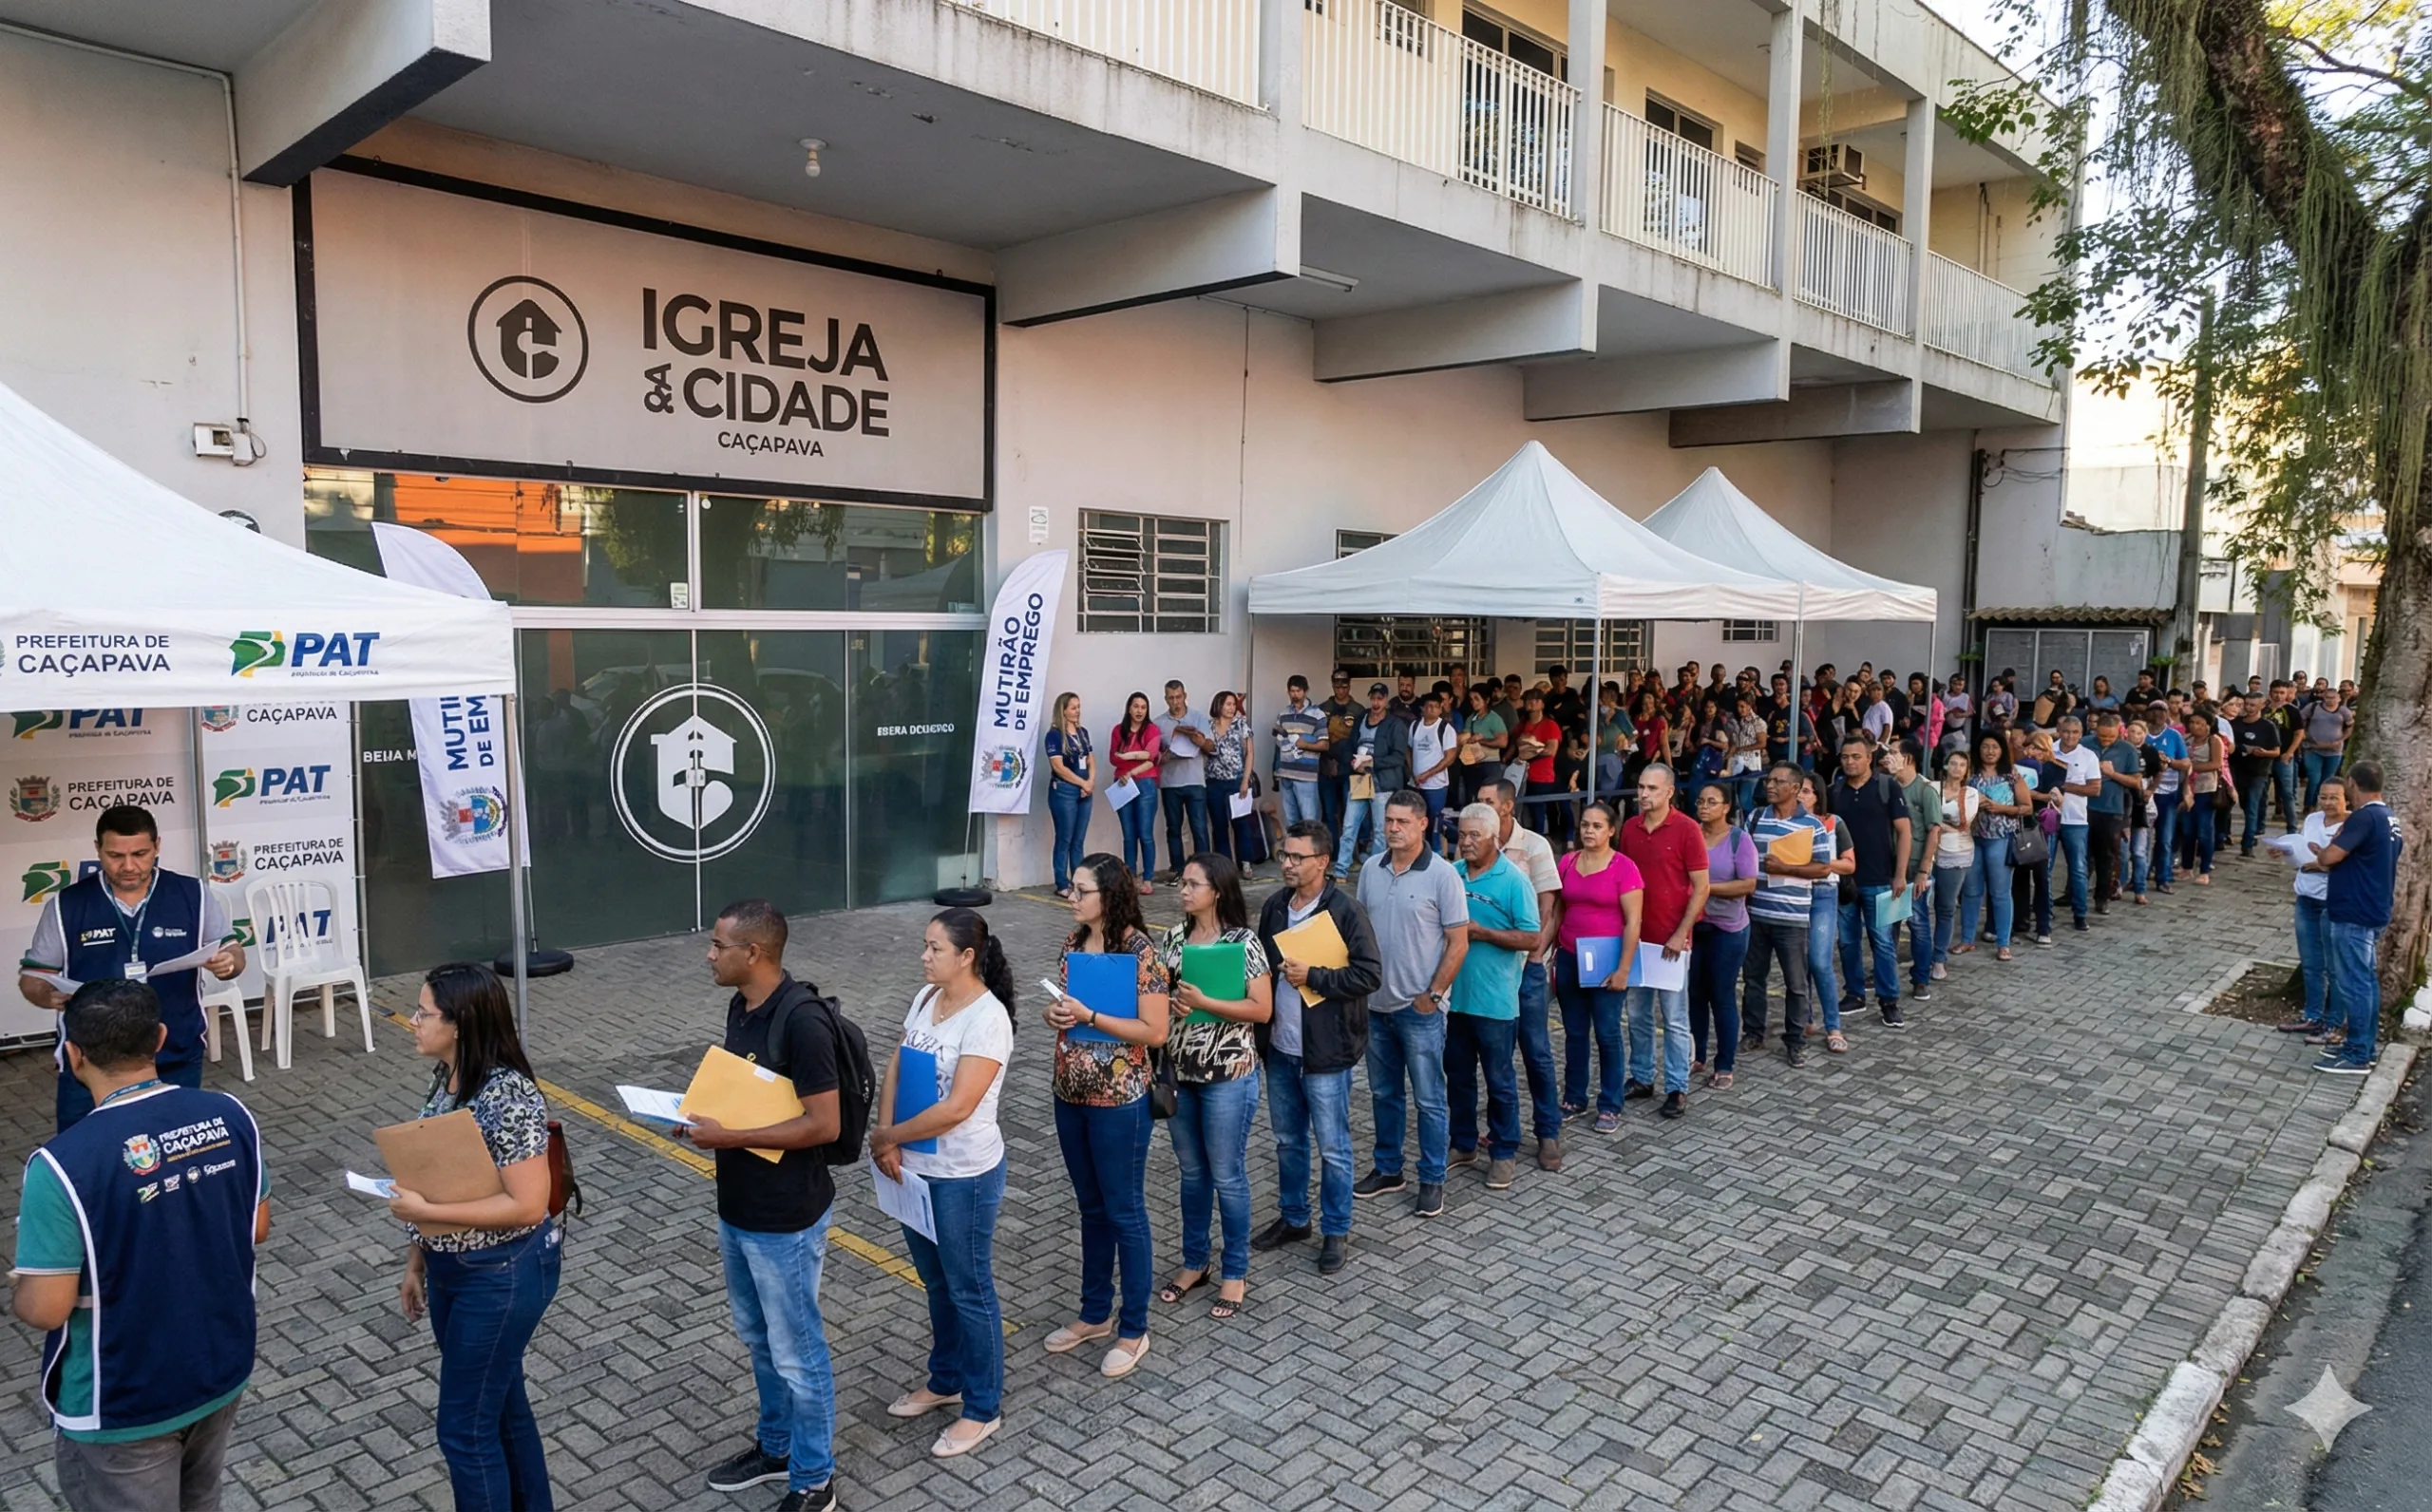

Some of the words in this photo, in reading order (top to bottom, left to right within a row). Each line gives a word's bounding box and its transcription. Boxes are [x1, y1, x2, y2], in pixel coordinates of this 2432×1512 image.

[643, 288, 889, 382] IGREJA
[683, 368, 889, 437] CIDADE
[718, 431, 825, 457] CAÇAPAVA
[16, 635, 140, 649] PREFEITURA
[145, 635, 170, 648] DE
[291, 633, 380, 667] PAT
[1015, 593, 1043, 704] EMPREGO
[18, 653, 170, 677] CAÇAPAVA
[994, 616, 1020, 728] MUTIRÃO
[247, 707, 337, 725] CAÇAPAVA
[1015, 709, 1026, 730] DE
[440, 696, 469, 770] MUTI
[477, 740, 494, 766] DE
[68, 779, 153, 793] PREFEITURA
[157, 777, 174, 787] DE
[260, 765, 331, 796] PAT
[255, 840, 326, 855] PREFEITURA
[329, 838, 343, 848] DE
[255, 850, 344, 871] CAÇAPAVA
